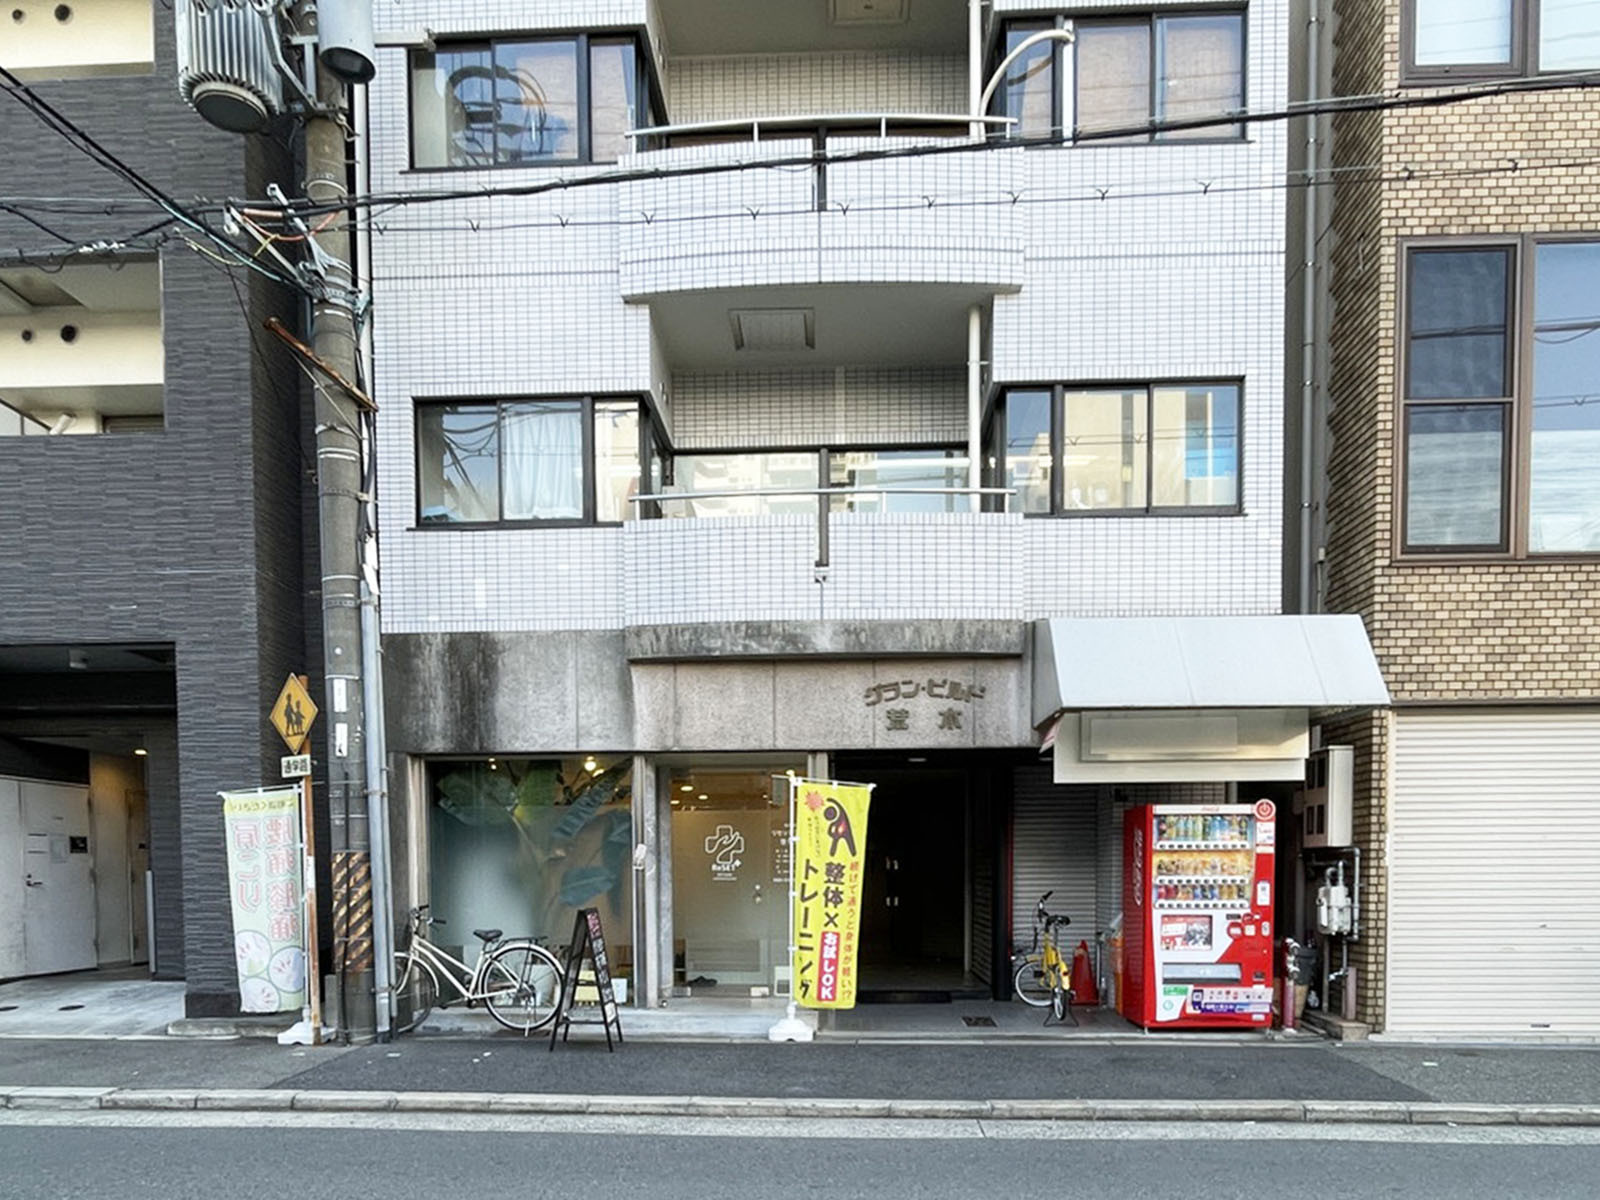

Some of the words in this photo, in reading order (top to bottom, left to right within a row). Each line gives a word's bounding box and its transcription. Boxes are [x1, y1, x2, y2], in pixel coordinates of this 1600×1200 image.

[864, 678, 987, 707] グラン・ビルド
[799, 858, 819, 999] トレーニング
